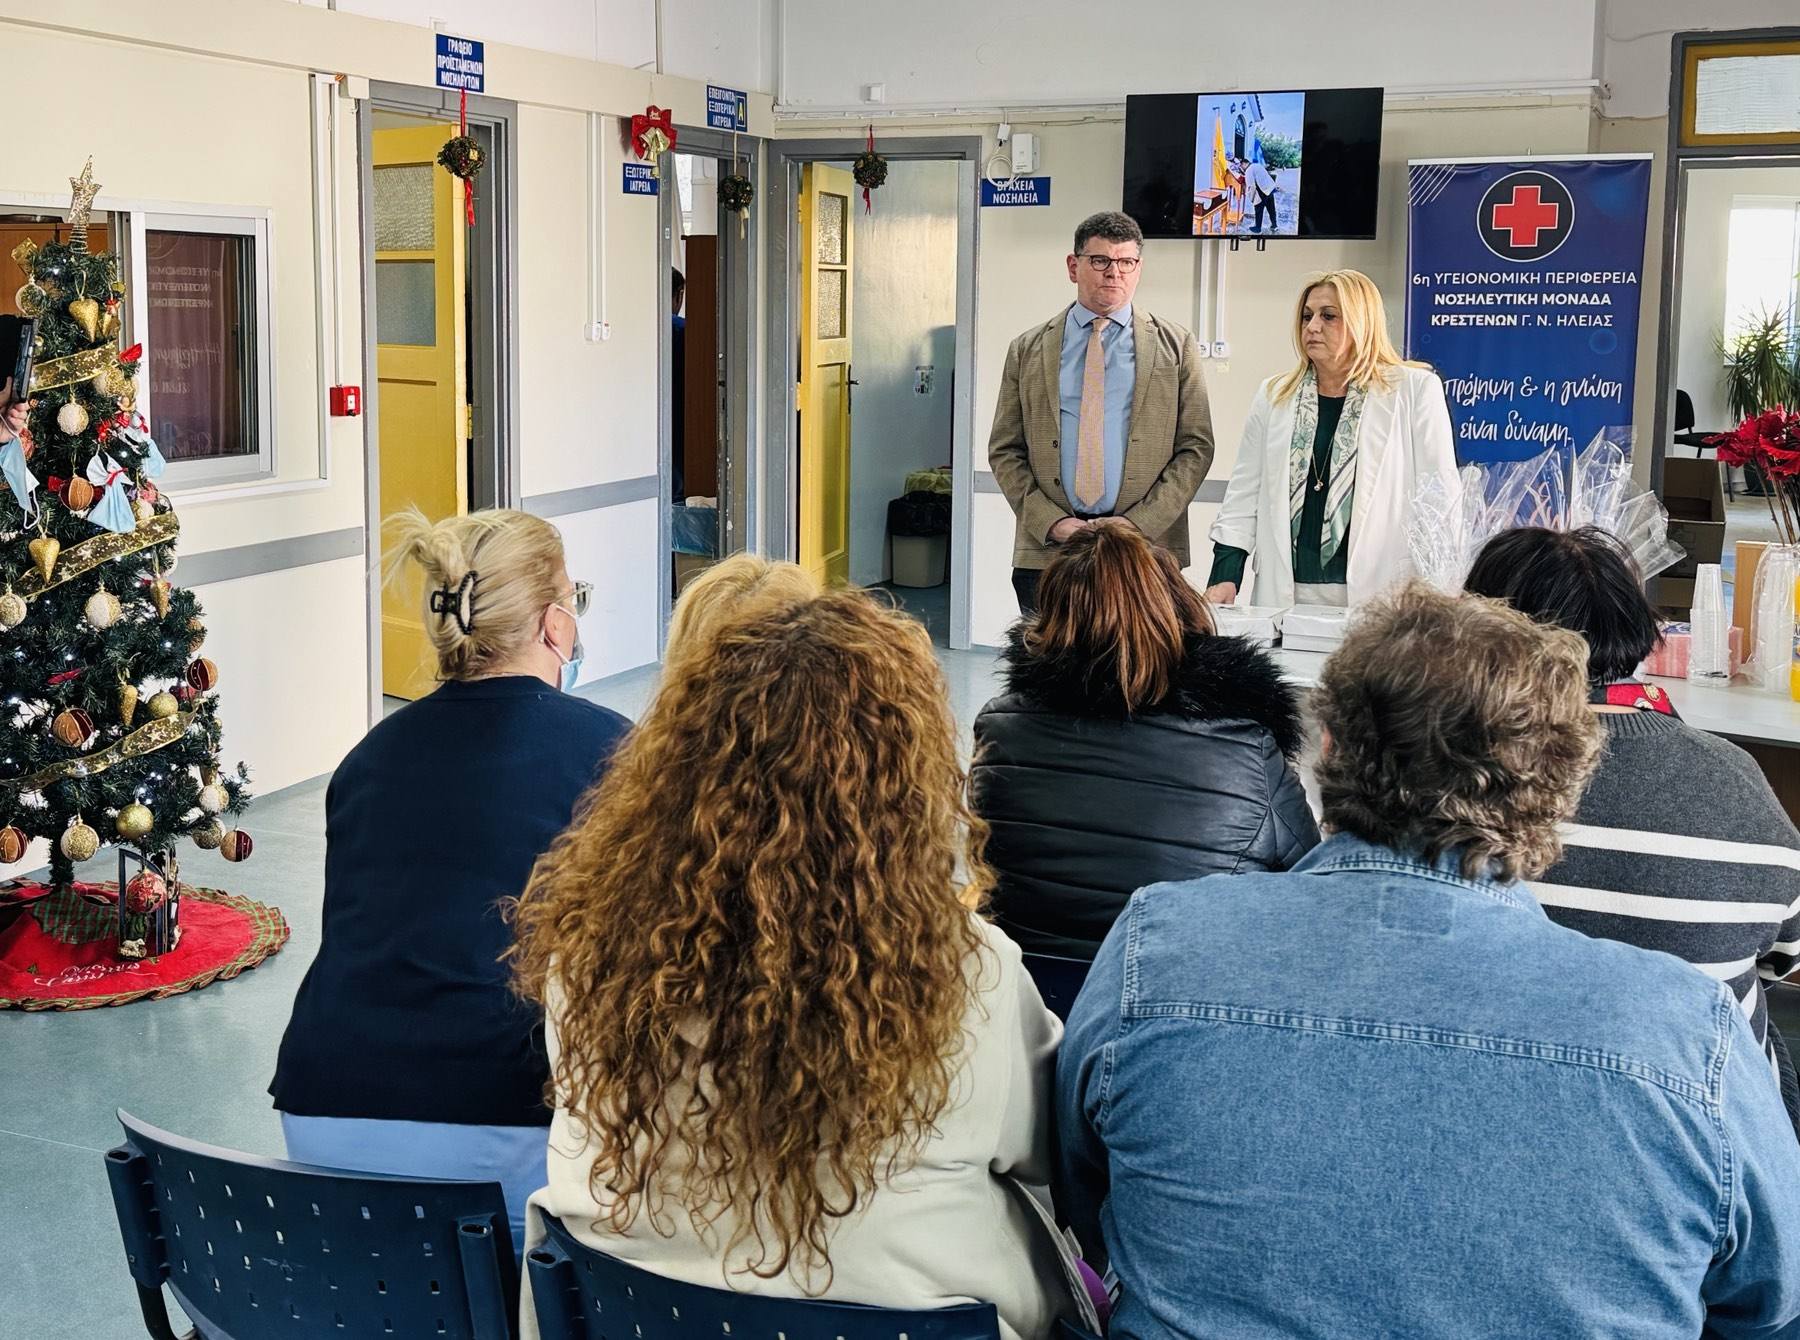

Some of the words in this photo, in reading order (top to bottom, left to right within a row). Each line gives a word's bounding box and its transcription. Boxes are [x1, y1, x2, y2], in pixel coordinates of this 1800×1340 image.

[629, 180, 651, 193] ΙΑΤΡΕΙΑ
[992, 192, 1039, 204] ΝΟΣΗΛΕΙΑ
[1412, 274, 1430, 287] 6η
[1434, 272, 1541, 285] ΥΓΕΙΟΝΟΜΙΚΗ
[1545, 271, 1638, 284] ΠΕΡΙΦΕΡΕΙΑ
[1434, 293, 1538, 306] ΝΟΣΗΛΕΥΤΙΚΗ
[1541, 293, 1612, 306] ΜΟΝΑΔΑ
[1431, 314, 1518, 327] ΚΡΕΣΤΕΝΩΝ
[1521, 314, 1532, 327] Γ.
[1536, 314, 1552, 327] Ν.
[1556, 314, 1613, 327] ΗΛΕΙΑΣ
[1519, 375, 1538, 398] &
[1543, 379, 1555, 403] η
[1561, 373, 1623, 407] γνώση
[1459, 415, 1498, 441] είναι
[1503, 409, 1572, 448] δύναμη.
